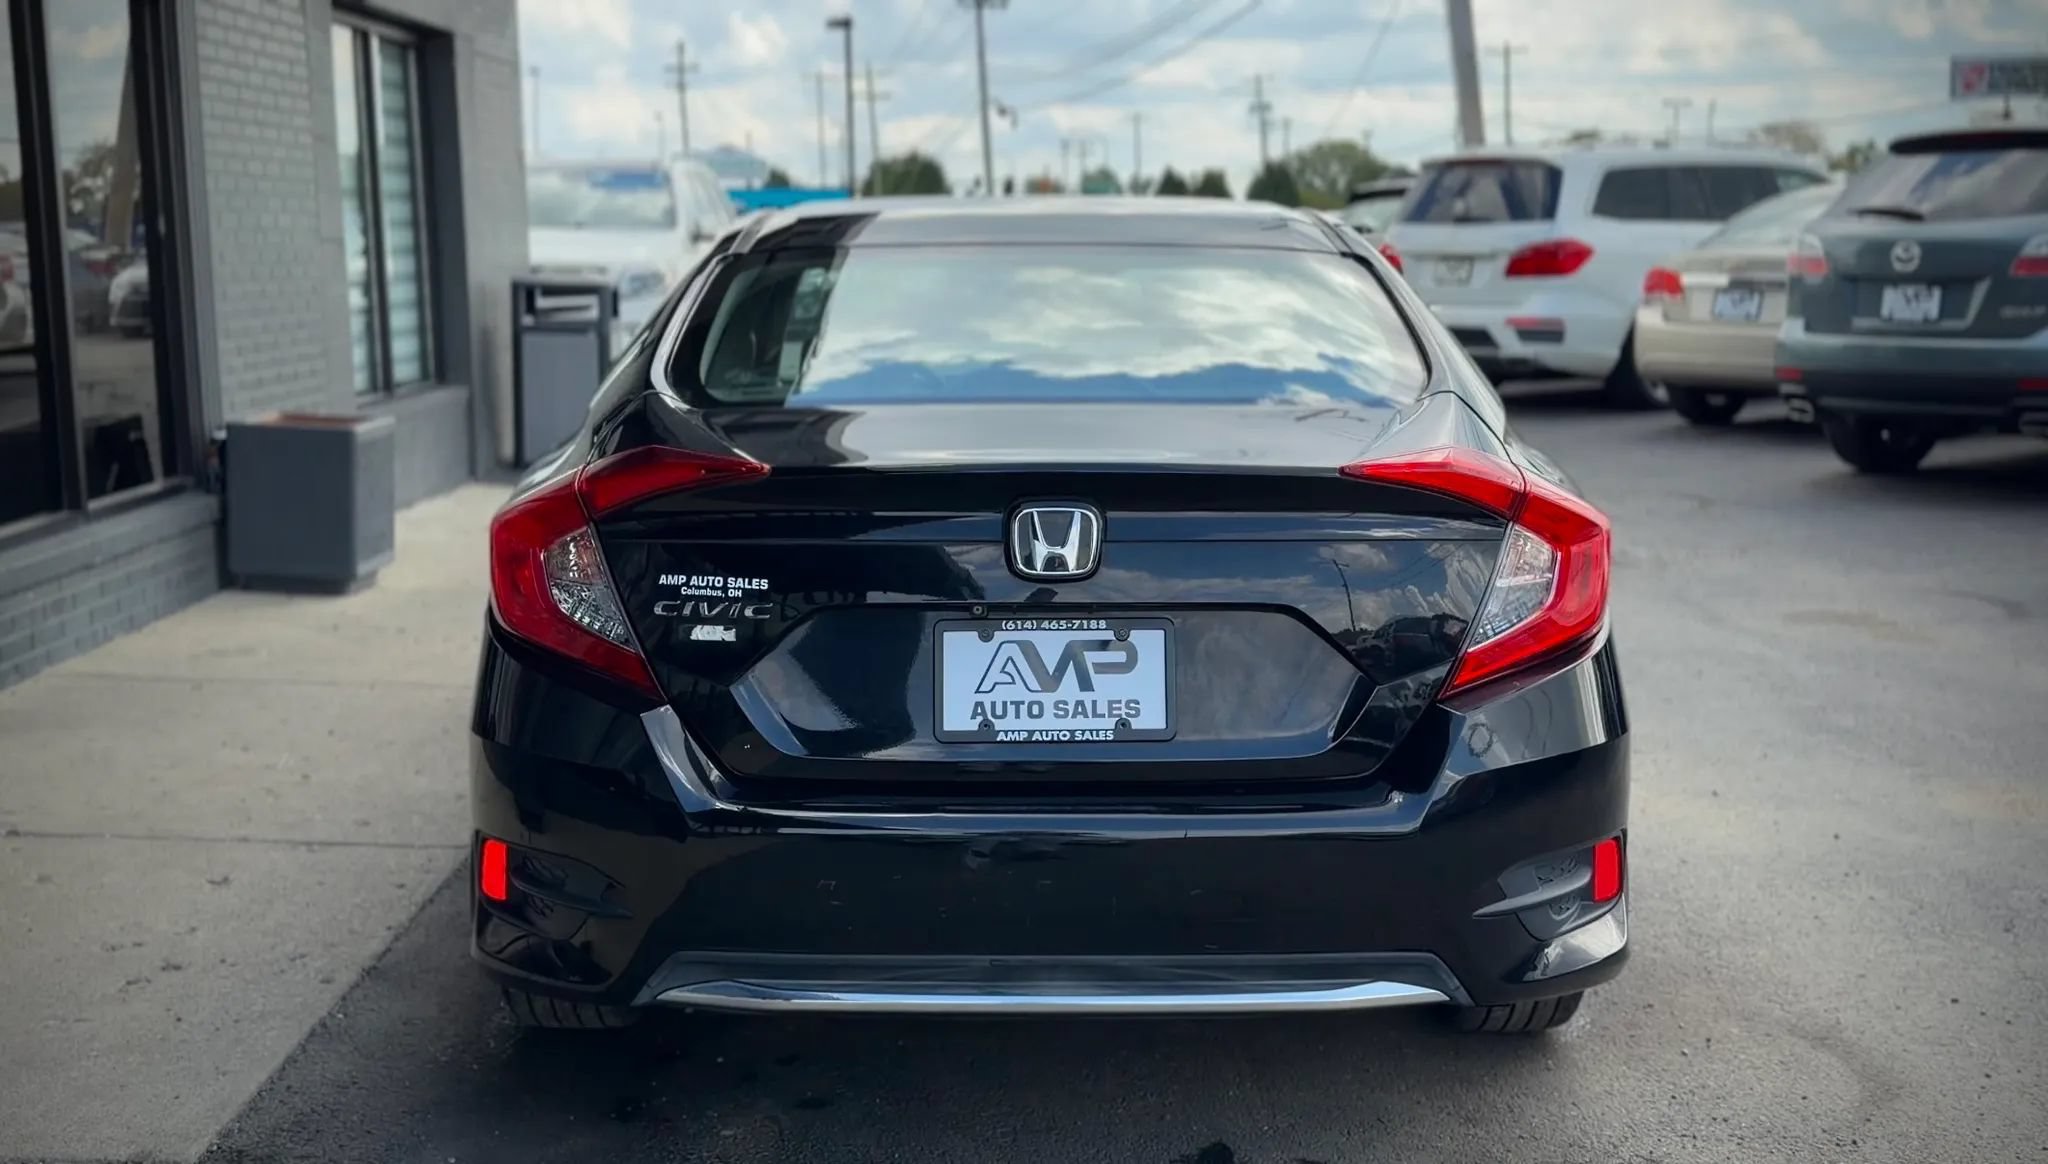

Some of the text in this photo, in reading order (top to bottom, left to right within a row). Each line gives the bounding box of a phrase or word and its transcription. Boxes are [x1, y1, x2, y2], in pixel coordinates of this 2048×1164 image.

[658, 574, 769, 590] AMP AUTO SALES
[681, 586, 742, 598] Columbus, OH
[653, 600, 773, 619] CIVIC
[1002, 619, 1107, 631] (614) 465-7188
[974, 639, 1139, 694] AMP
[970, 699, 1141, 720] AUTO SALES
[996, 730, 1114, 742] AMP AUTO SALES
